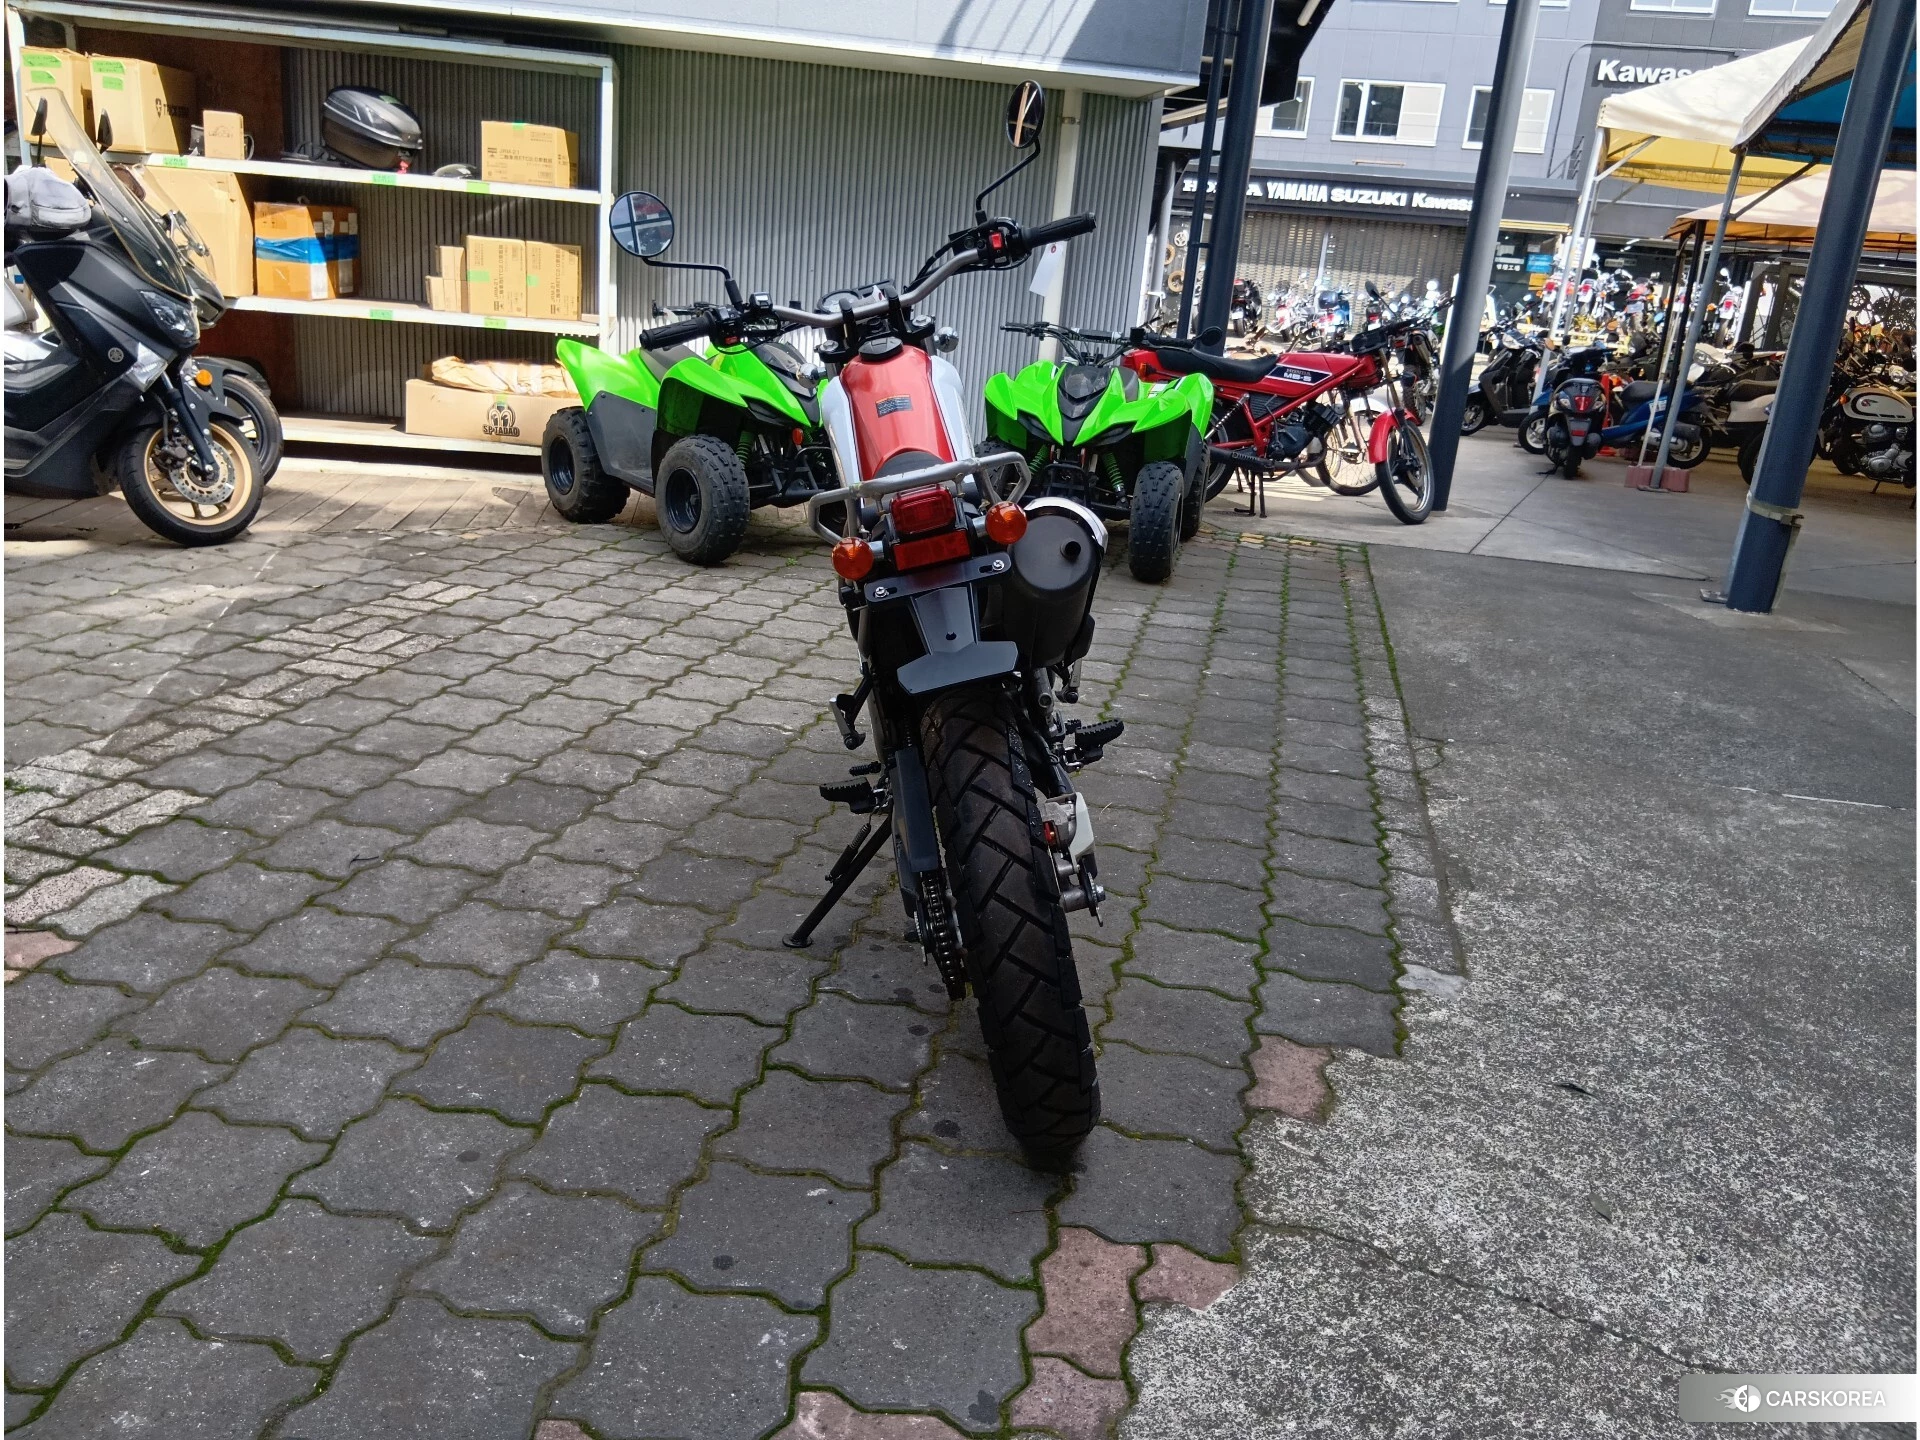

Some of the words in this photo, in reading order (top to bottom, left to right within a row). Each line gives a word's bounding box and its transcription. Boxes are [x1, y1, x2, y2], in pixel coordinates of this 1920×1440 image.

[1597, 59, 1704, 83] Kawas
[1267, 181, 1328, 203] YAMAHA
[1330, 188, 1407, 207] SUZUKI
[1412, 192, 1473, 212] Kawas
[1286, 368, 1311, 376] HONDA
